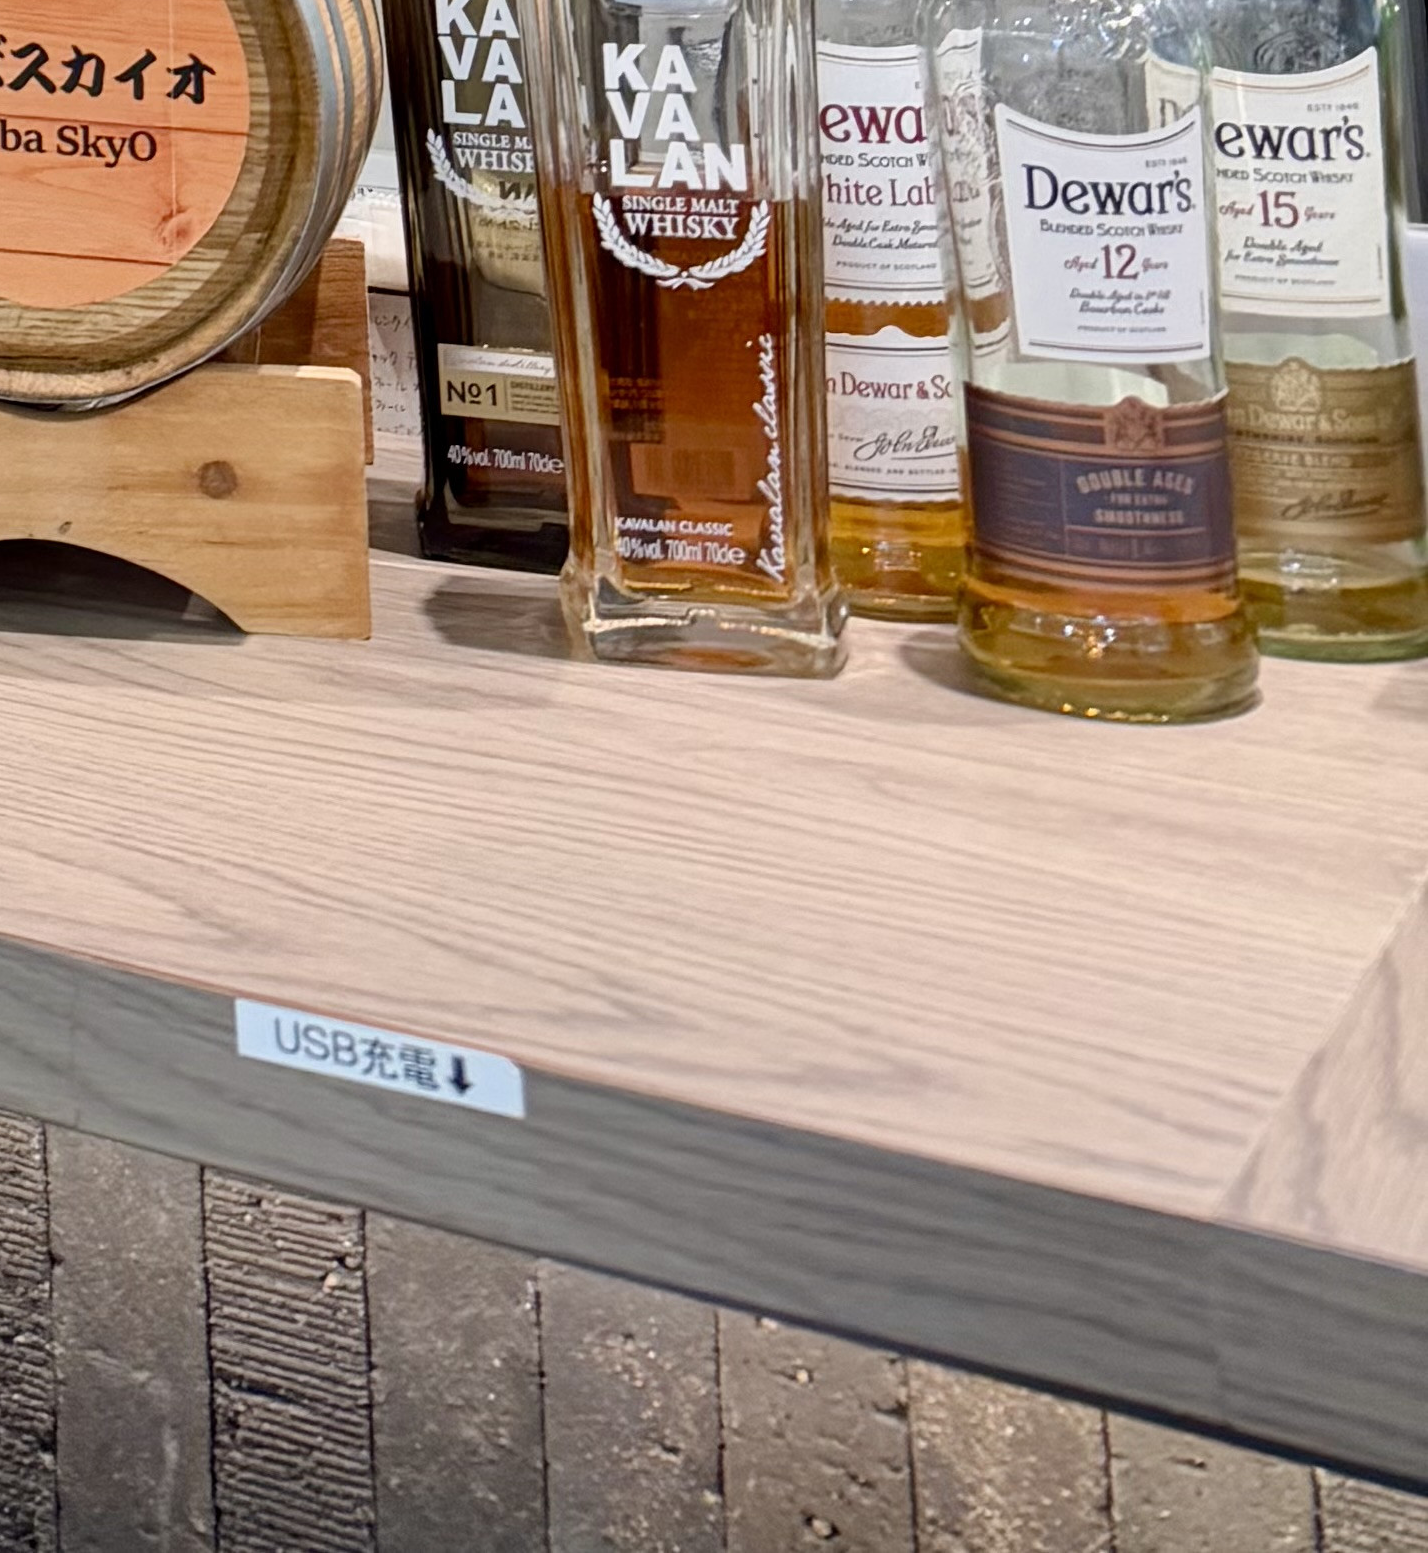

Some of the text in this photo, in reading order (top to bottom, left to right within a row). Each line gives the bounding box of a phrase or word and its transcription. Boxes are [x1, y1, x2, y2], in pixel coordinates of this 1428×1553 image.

[438, 35, 523, 84] VA
[602, 42, 699, 93] KA
[607, 91, 702, 142] VA
[55, 124, 157, 168] SkyO
[452, 130, 511, 148] SINGLE
[609, 138, 748, 192] LAN
[1253, 168, 1307, 184] SCOTCH
[1020, 162, 1192, 216] Dewar's
[621, 195, 740, 215] SINGLE MALT
[1219, 189, 1300, 229] Aged 15
[623, 213, 740, 241] WHISKY
[1040, 219, 1146, 238] BLENDED SCOTCH
[835, 260, 876, 270] PRODUCT
[1064, 243, 1169, 281] Aged 12 Years
[841, 371, 929, 401] Dewar &
[1076, 469, 1195, 496] DOUBLE AGED
[615, 516, 735, 537] KAVALAN CLASSIC
[666, 539, 703, 563] 700ml
[274, 1017, 441, 1092] USB充電
